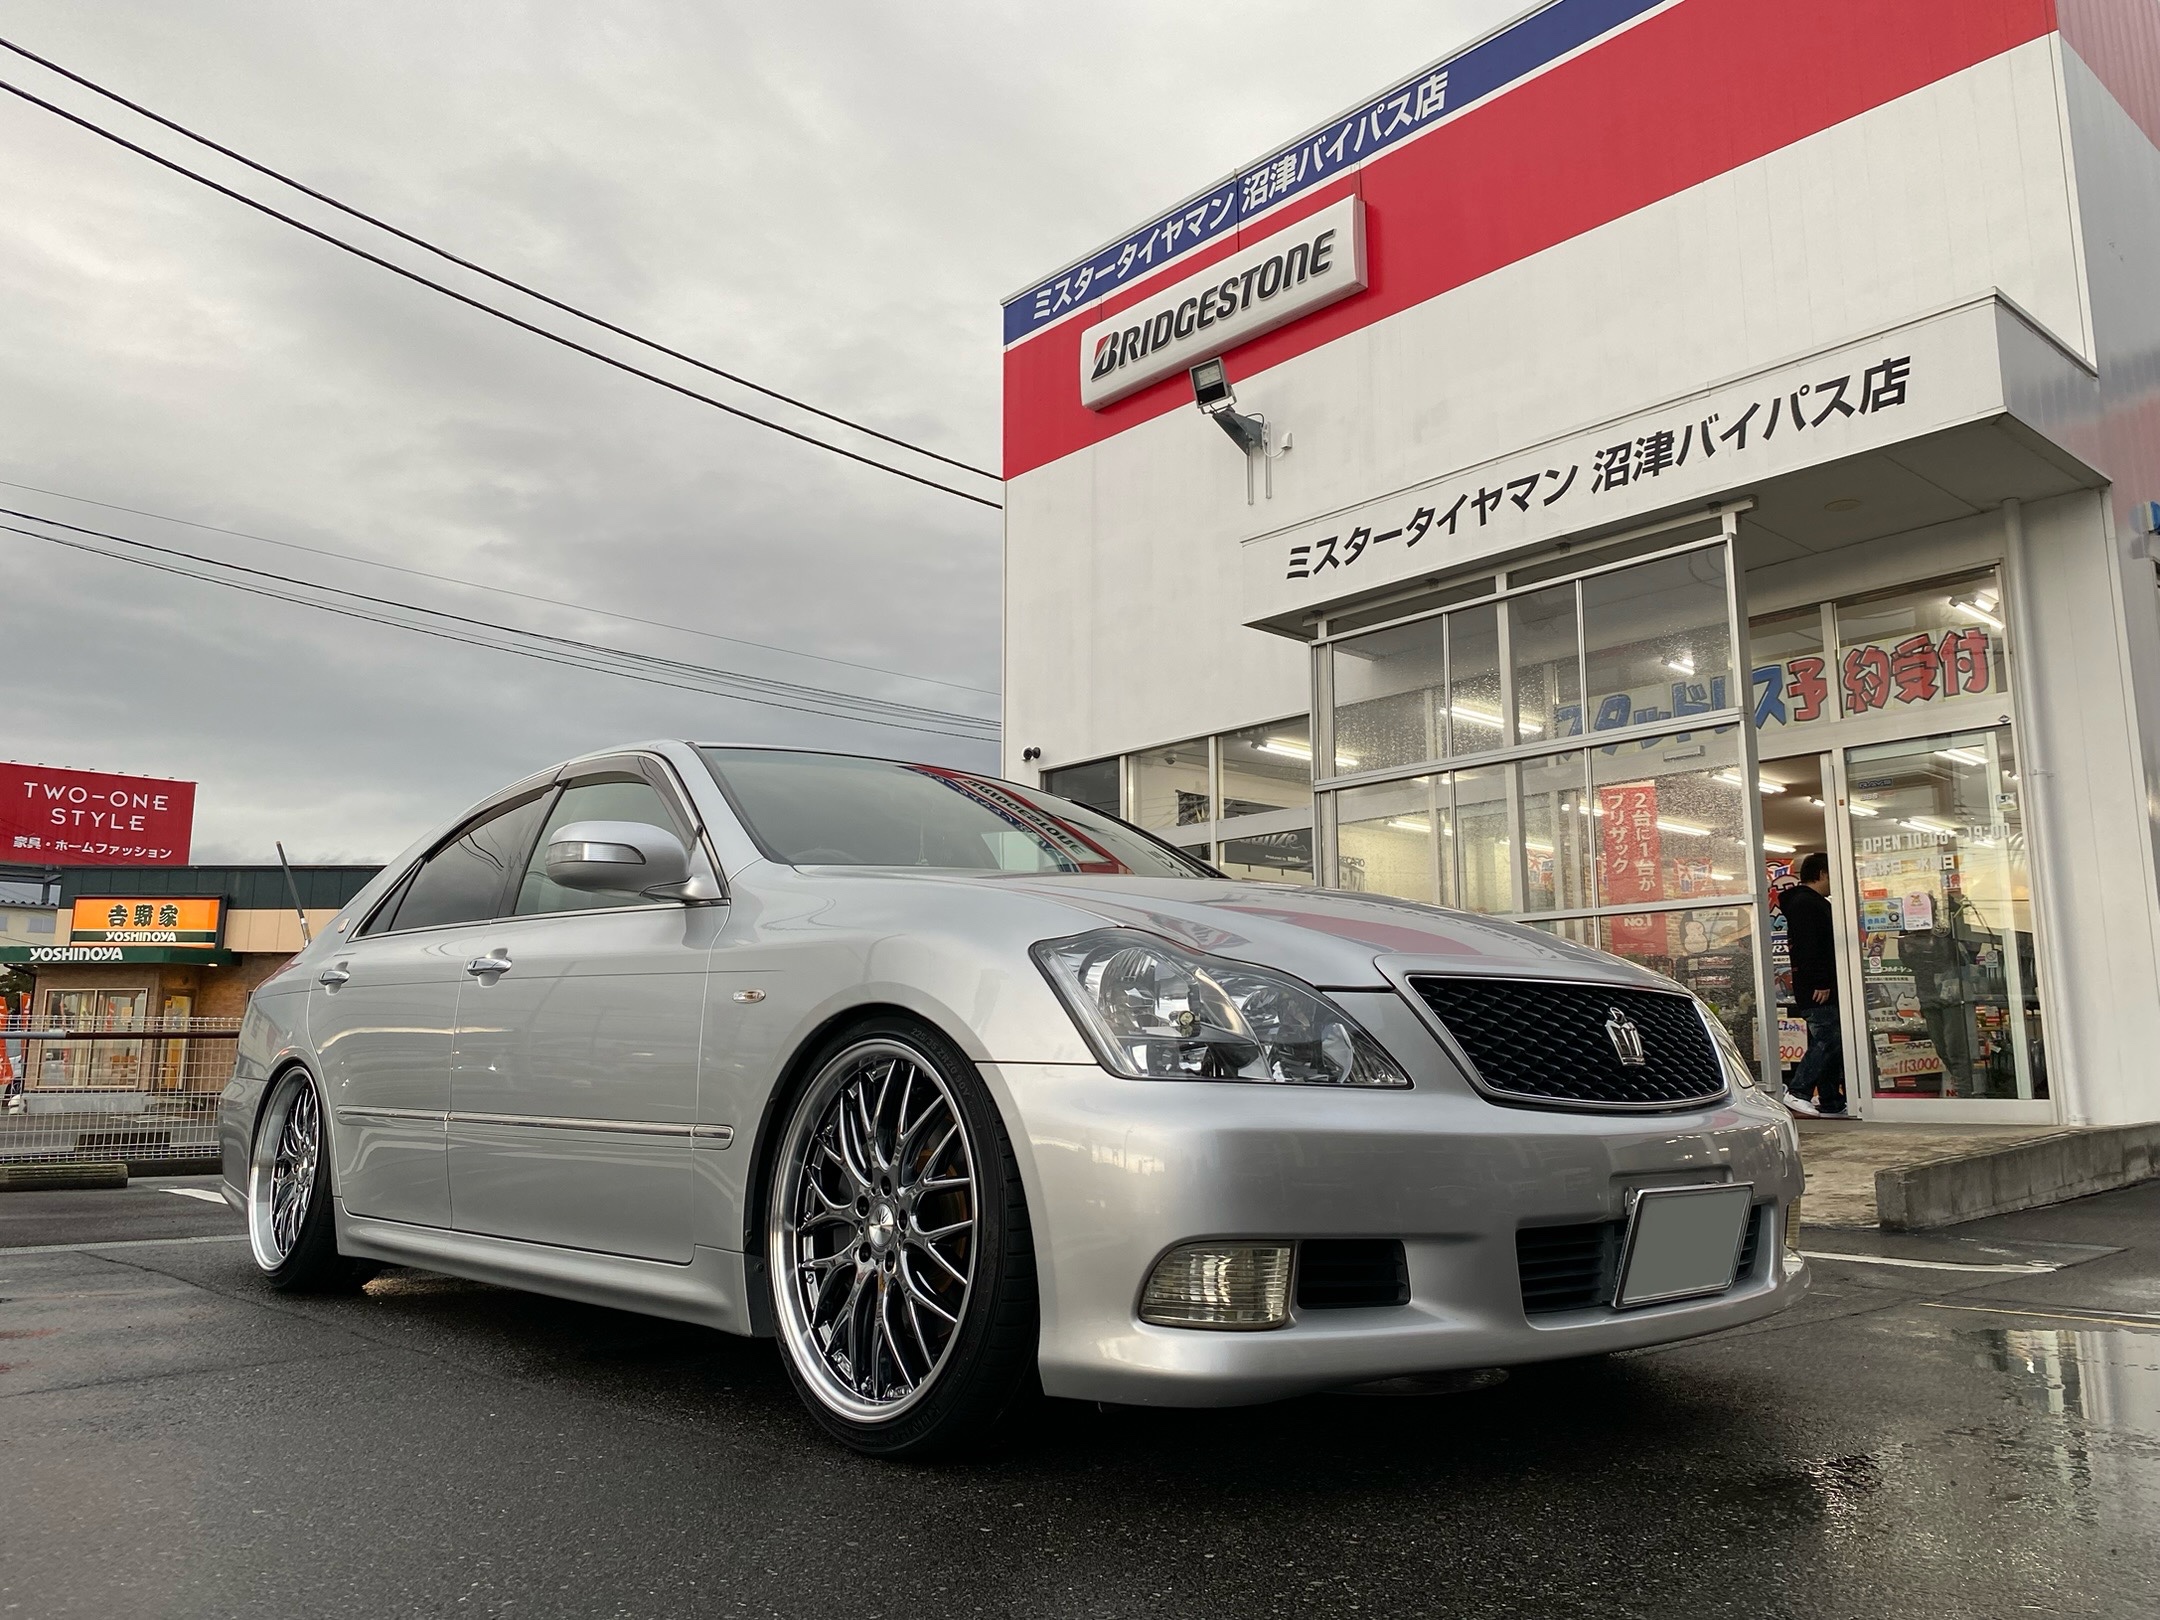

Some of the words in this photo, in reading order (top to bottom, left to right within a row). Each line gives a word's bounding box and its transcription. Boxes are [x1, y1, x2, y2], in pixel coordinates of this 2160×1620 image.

[1033, 192, 1234, 320] ミスタータイヤマン
[1241, 70, 1449, 214] 沼津バイパス店
[1090, 227, 1337, 381] BRIDGESTONE
[1285, 463, 1579, 580] ミスタータイヤマン
[1590, 356, 1911, 494] 沼津バイパス店
[24, 781, 169, 811] TWO-ONE
[50, 808, 145, 831] STYLE
[1607, 792, 1629, 874] ブリザック
[13, 836, 172, 859] 家具・ホームファッション
[1631, 792, 1656, 892] 2台に1台が
[1863, 835, 1901, 852] OPEN
[105, 931, 177, 942] YOSHINOYA
[29, 947, 123, 961] YOSHINOYA
